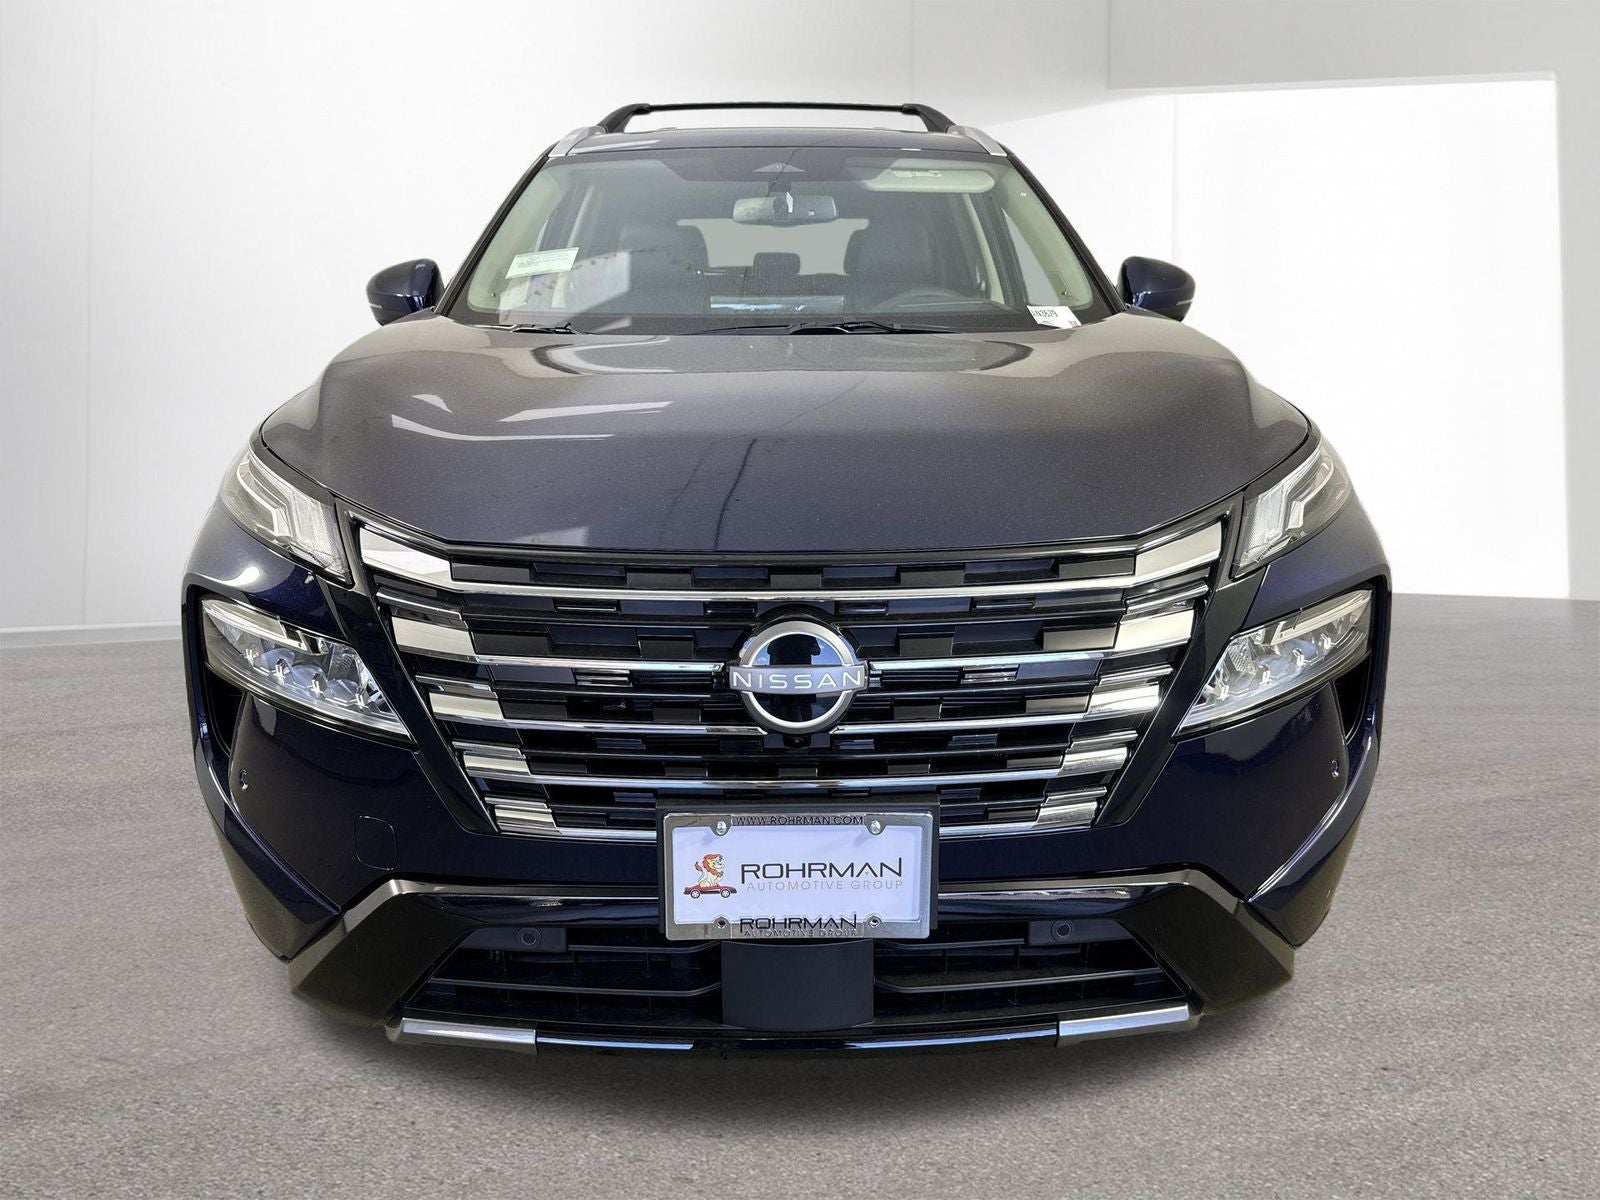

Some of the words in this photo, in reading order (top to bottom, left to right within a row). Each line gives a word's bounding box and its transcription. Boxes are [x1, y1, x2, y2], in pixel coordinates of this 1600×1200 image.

[732, 670, 861, 689] NISSAN
[736, 815, 864, 825] WWW.ROHRMAN.COM
[741, 857, 902, 884] ROHRMAN
[747, 880, 843, 891] AUTOMOTIVE
[850, 879, 903, 890] GROUP
[740, 914, 857, 933] ROHRMAN
[743, 929, 813, 937] AUTOMOTIVE
[818, 928, 856, 937] GROUP
